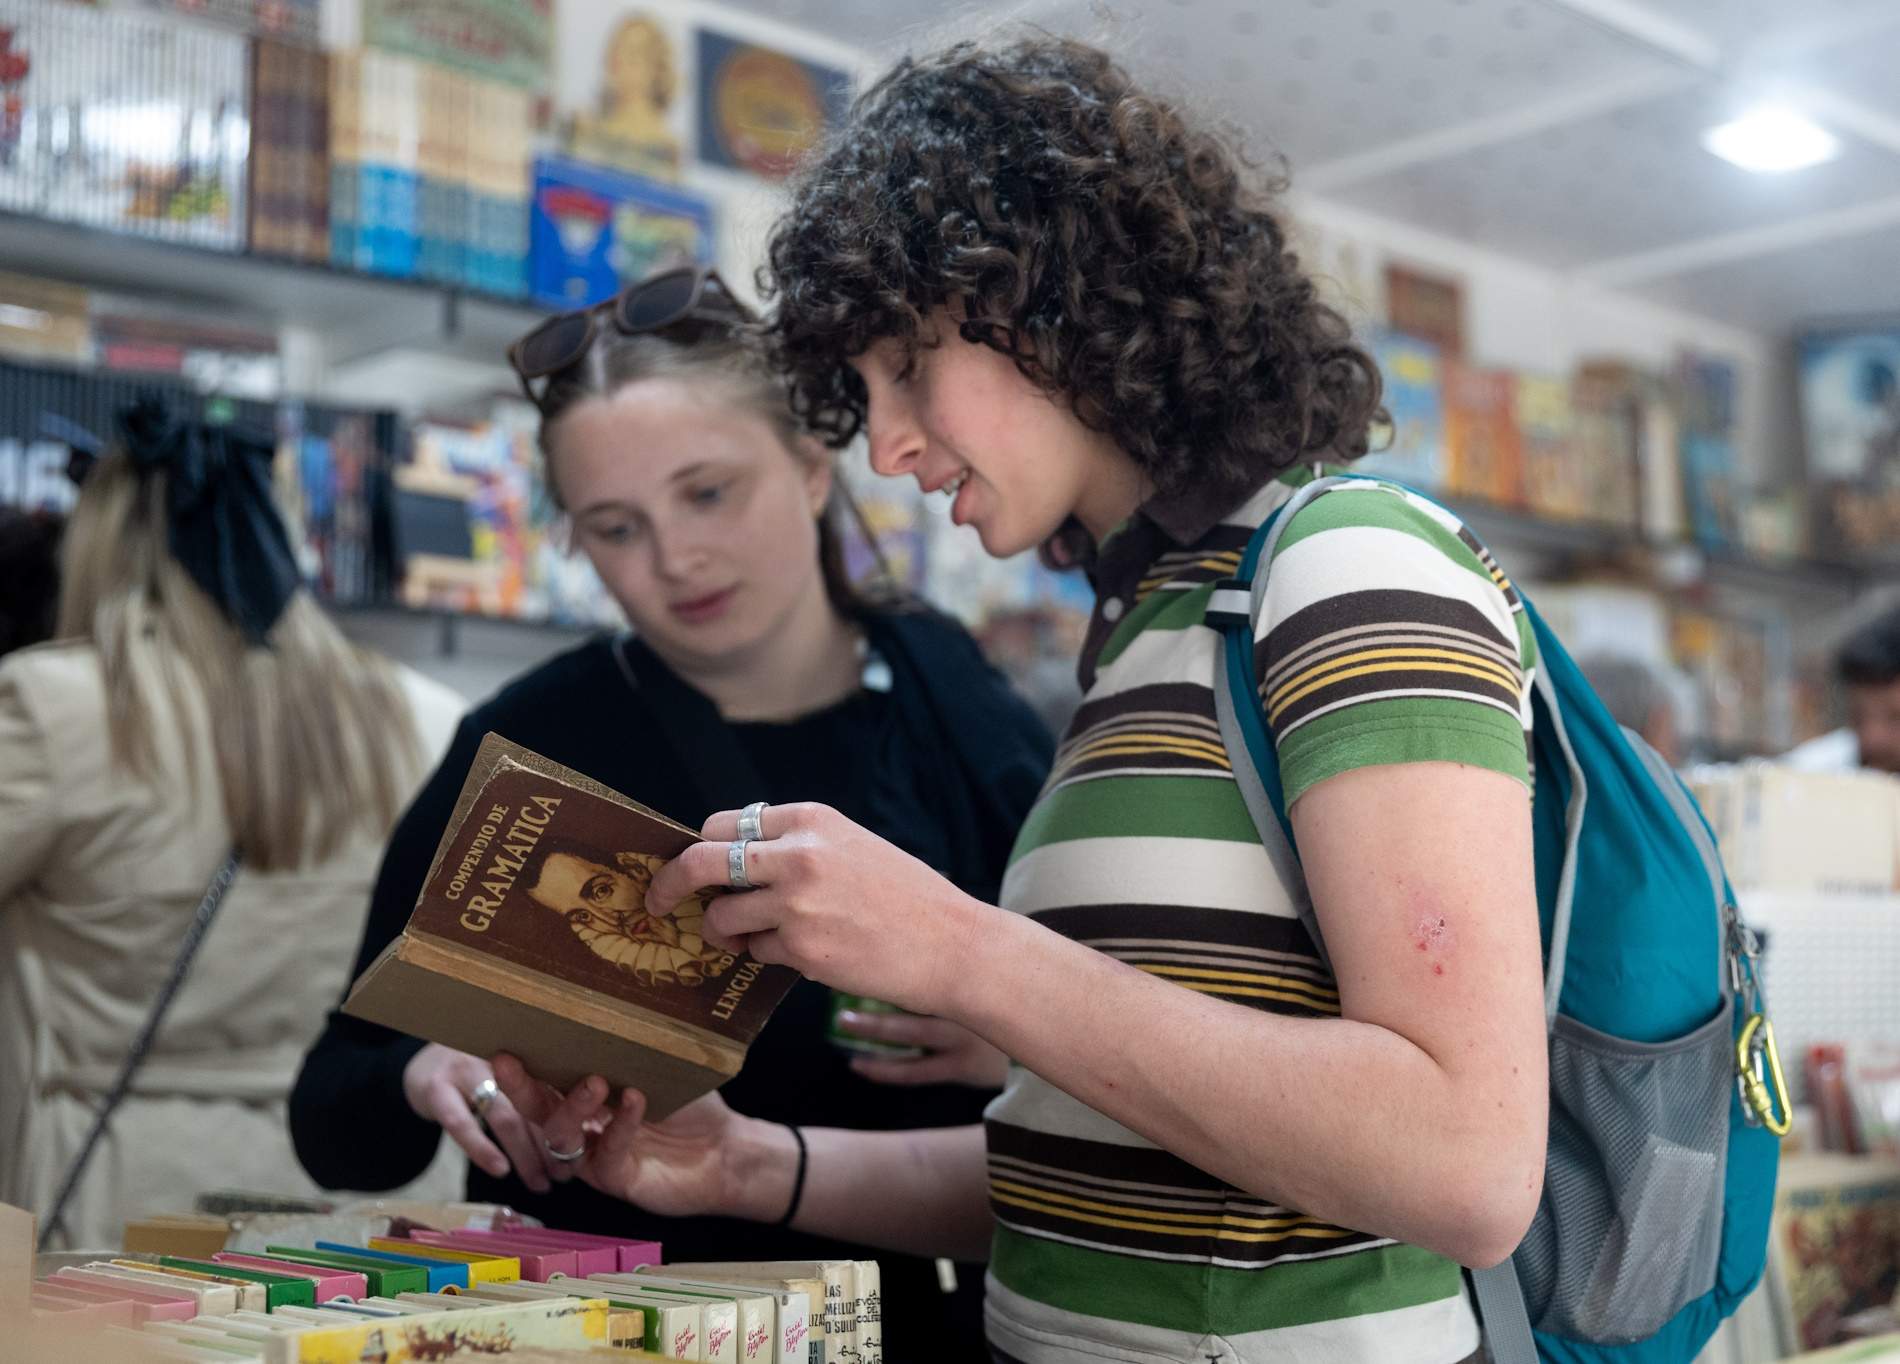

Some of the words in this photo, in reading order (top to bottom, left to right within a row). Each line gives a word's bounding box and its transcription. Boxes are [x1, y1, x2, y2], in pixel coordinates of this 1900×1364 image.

[445, 824, 497, 900] COMPENDIO
[486, 803, 510, 825] DE
[459, 796, 563, 932] GRAMATICA
[711, 962, 765, 1020] LENGUA
[824, 1283, 841, 1298] LAS
[825, 1302, 856, 1315] MELLIZA
